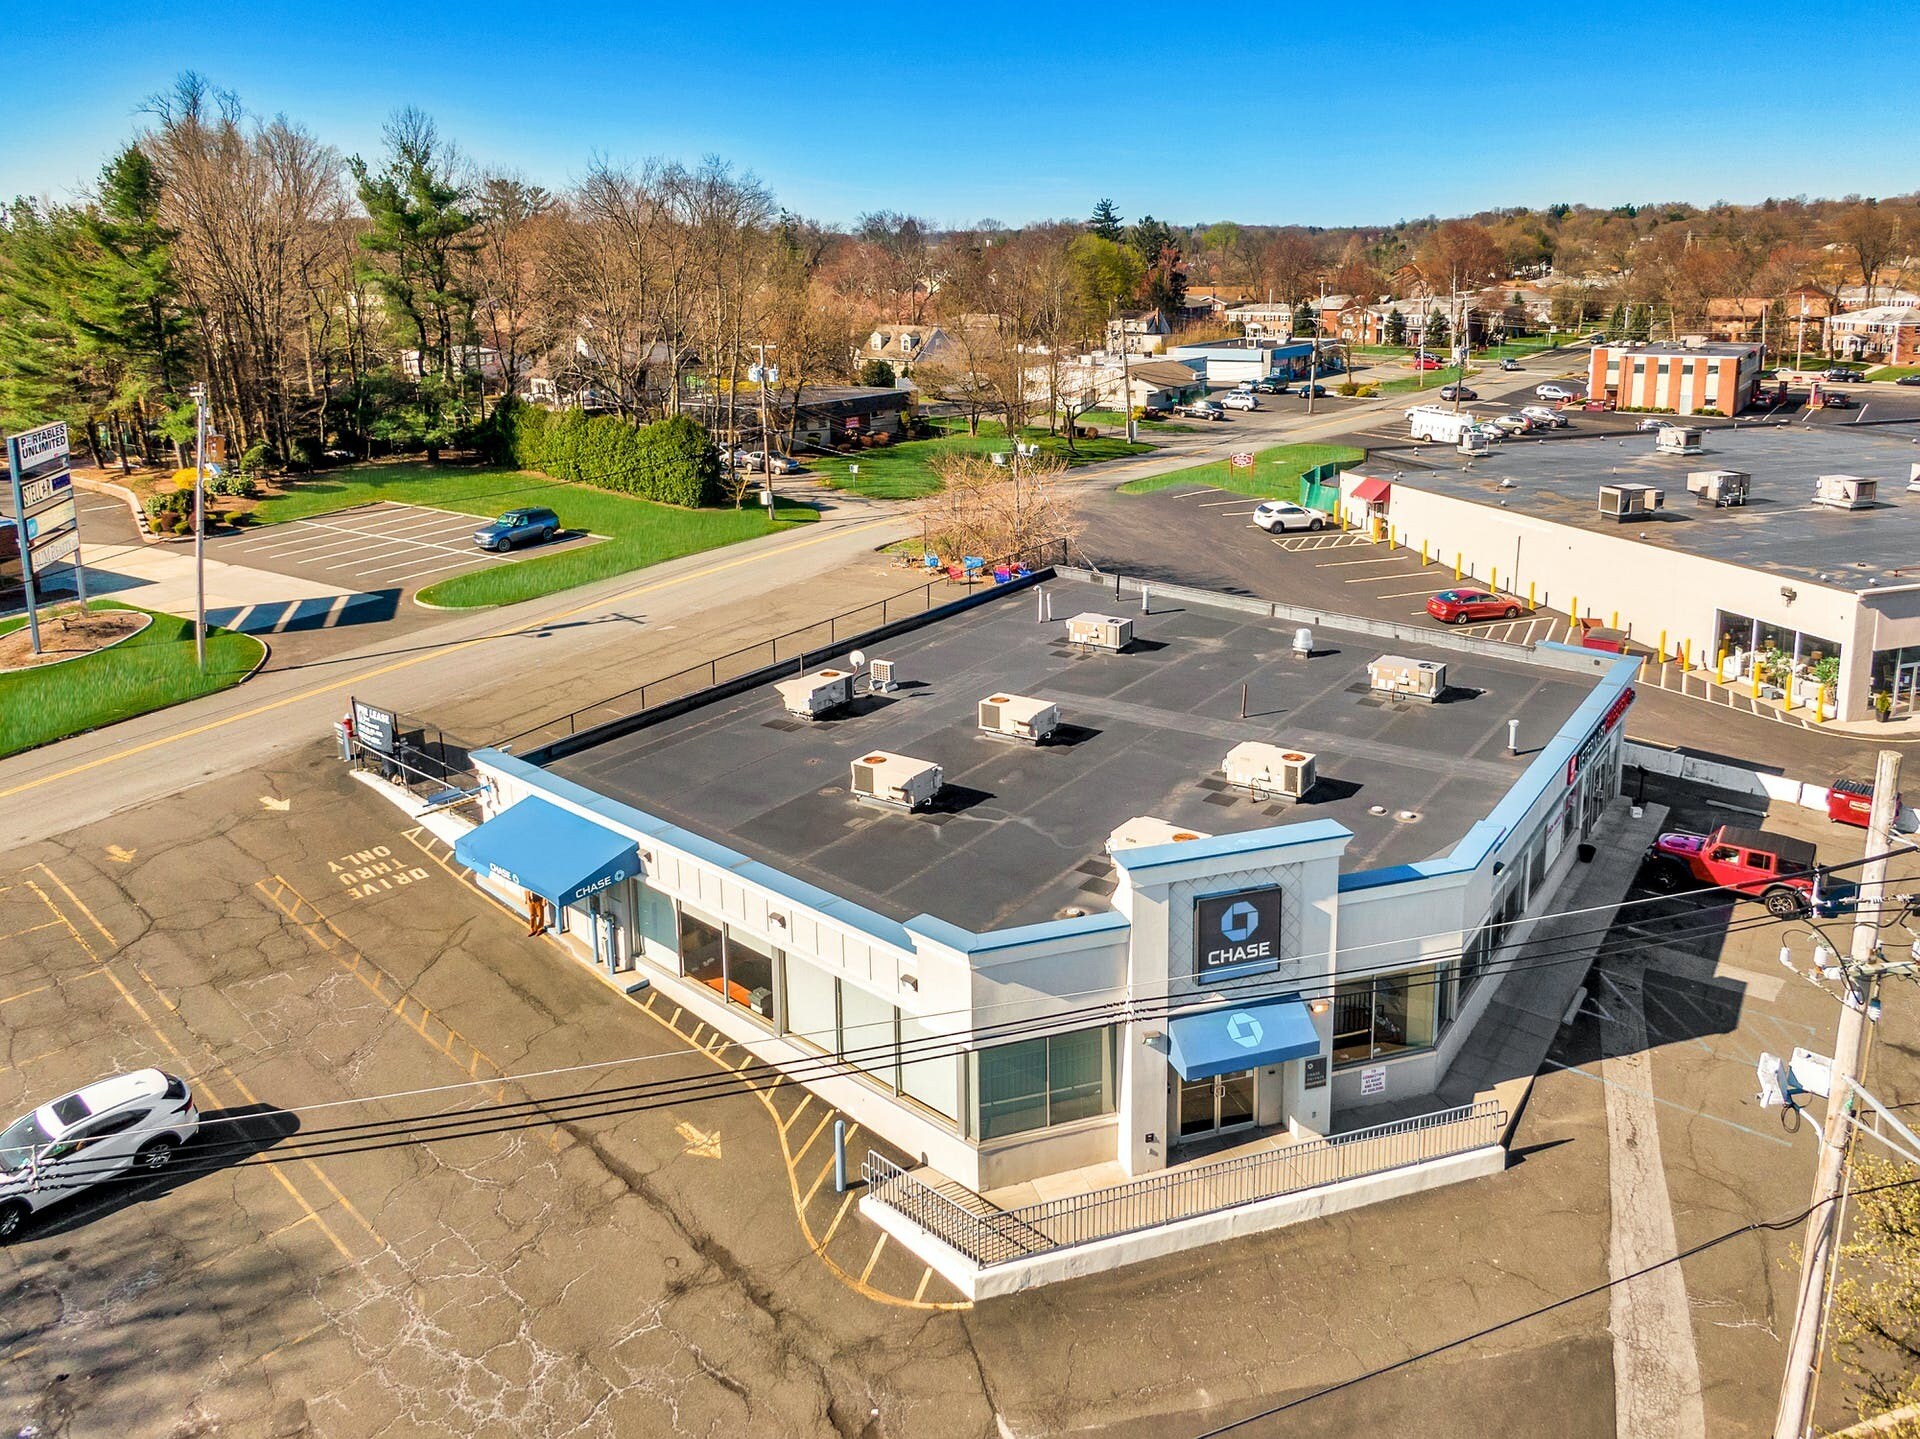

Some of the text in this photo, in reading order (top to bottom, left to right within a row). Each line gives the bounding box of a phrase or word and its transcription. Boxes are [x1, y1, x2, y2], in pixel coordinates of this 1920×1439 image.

[22, 436, 66, 459] UNLIMITED
[327, 845, 391, 873] ONLY
[339, 858, 408, 885] THRU
[345, 867, 430, 900] DRIVE
[575, 875, 612, 899] CHASE
[1207, 941, 1271, 966] CHASE
